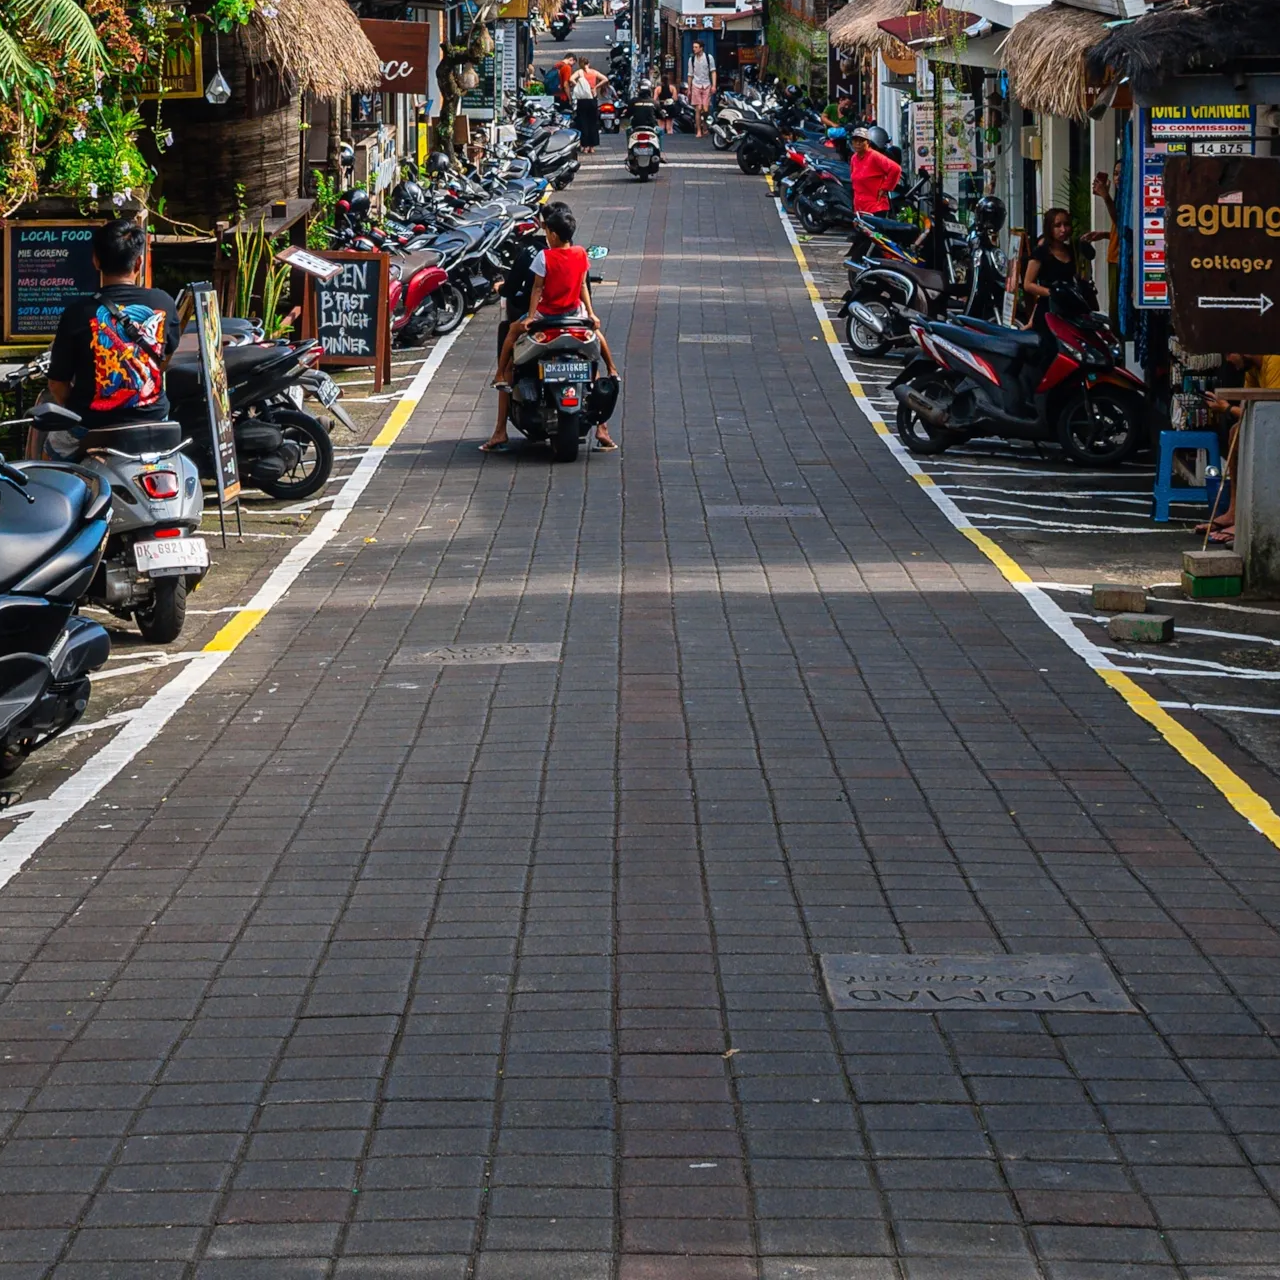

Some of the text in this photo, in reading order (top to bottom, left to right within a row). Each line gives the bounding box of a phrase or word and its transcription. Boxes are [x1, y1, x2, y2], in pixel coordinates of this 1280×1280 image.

[21, 230, 93, 242] LOCAL FOOD
[18, 249, 69, 258] MIE GORENG
[1190, 255, 1273, 273] cottages
[17, 277, 75, 287] NASI GORENG
[18, 306, 40, 315] SOTO
[318, 311, 373, 329] LUNCH
[321, 336, 370, 355] DINNER
[136, 544, 151, 558] DK
